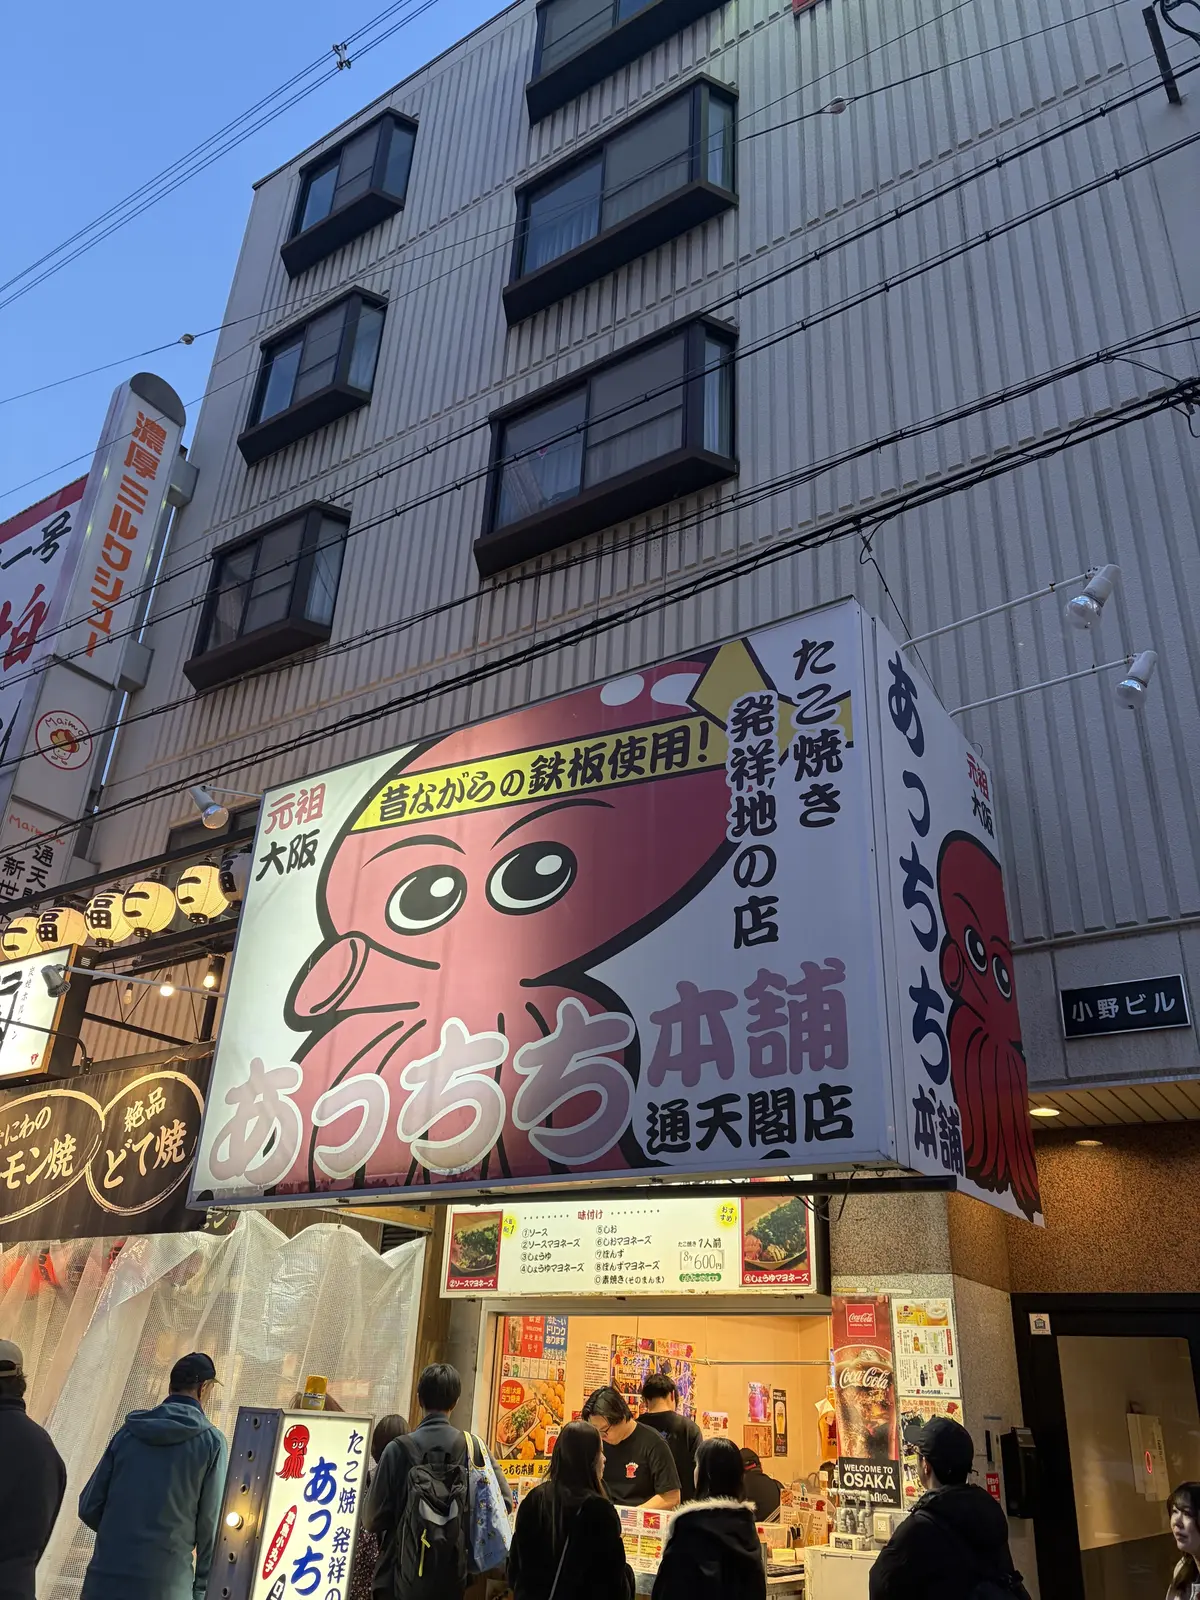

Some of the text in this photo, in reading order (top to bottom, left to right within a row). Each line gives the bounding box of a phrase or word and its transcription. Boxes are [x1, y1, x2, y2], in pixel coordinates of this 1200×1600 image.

[792, 637, 844, 828] たこ焼き
[378, 719, 711, 824] 昔ながらの鉄板使用!
[966, 751, 990, 803] 元祖
[265, 782, 326, 834] 元祖
[729, 694, 781, 950] 発祥地の店
[971, 789, 996, 840] 大阪
[255, 828, 321, 883] 大阪
[887, 649, 964, 1178] あっちち本舗
[1071, 991, 1176, 1022] 小野ビル
[207, 957, 850, 1187] あっちち本舗
[124, 1086, 167, 1132] 絶品
[647, 1082, 854, 1156] 通天閣店
[103, 1118, 187, 1189] どて焼
[577, 1209, 604, 1220] 味付け
[545, 1336, 566, 1346] あります
[546, 1325, 566, 1336] ドリンク
[839, 1366, 891, 1390] Coca-Cola
[337, 1429, 364, 1514] たこ焼
[843, 1463, 893, 1475] WELCOME TO
[843, 1472, 896, 1490] OSAKA
